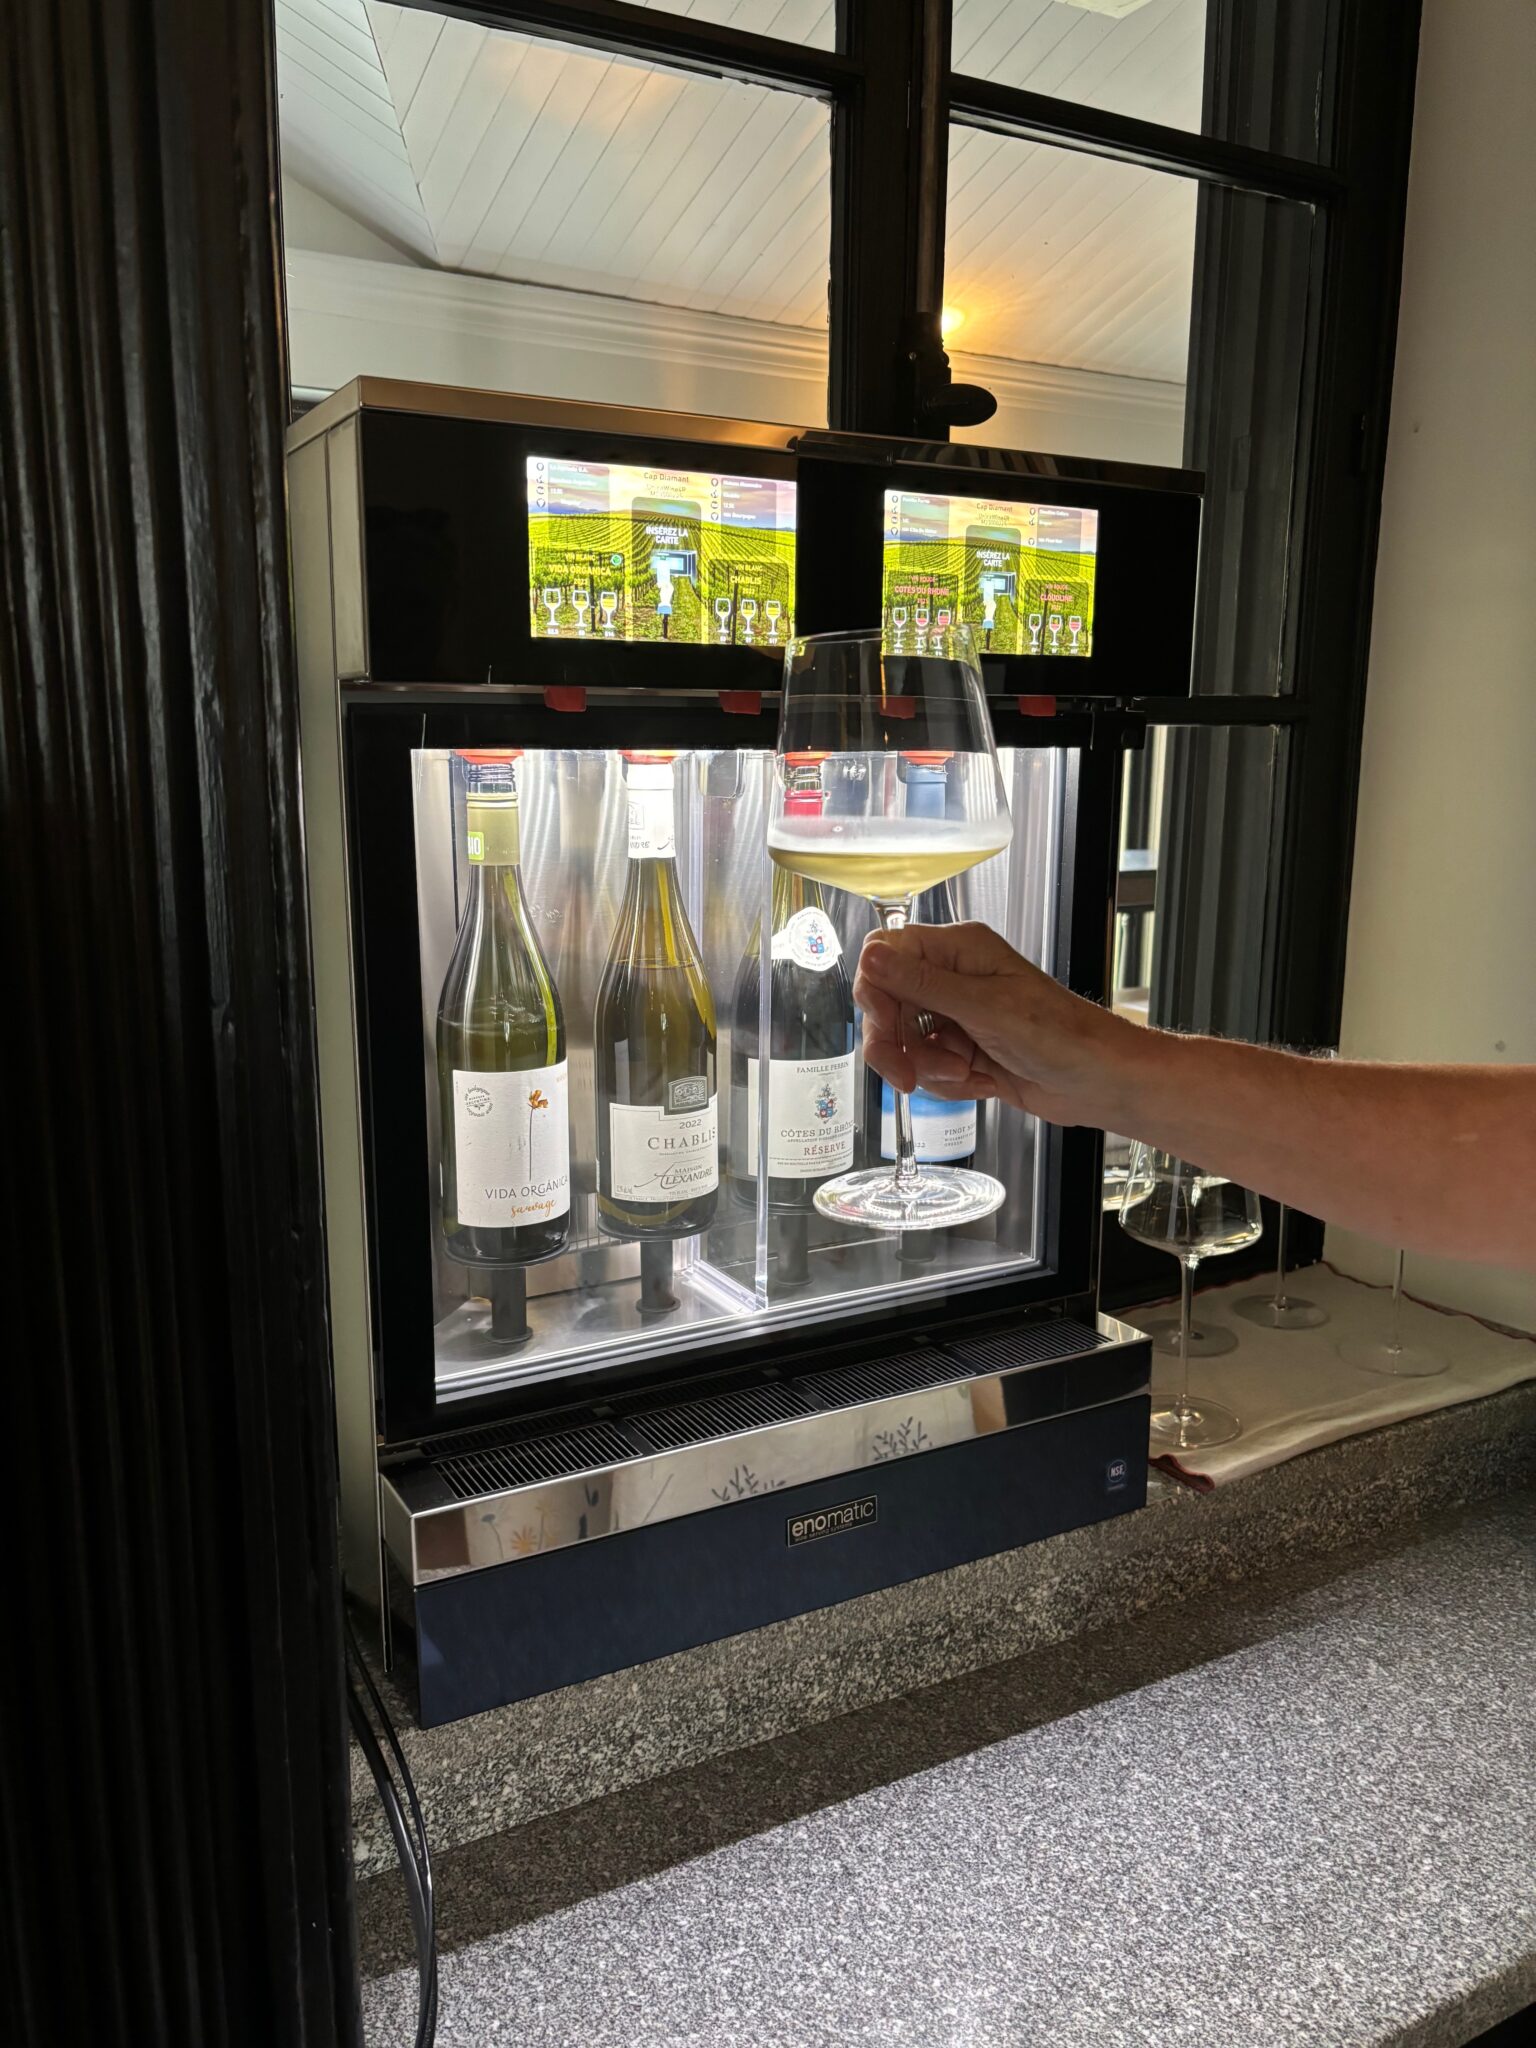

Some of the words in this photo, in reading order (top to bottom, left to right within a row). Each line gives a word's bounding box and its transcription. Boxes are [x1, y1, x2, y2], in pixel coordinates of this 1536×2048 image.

[679, 528, 689, 538] LA
[655, 535, 679, 545] CARTE
[1001, 552, 1010, 560] LA
[983, 559, 1002, 567] CARTE
[548, 564, 569, 574] VIDA
[730, 575, 762, 585] CHABLIS
[796, 1065, 829, 1074] FAMILLE
[679, 1119, 702, 1129] 2022
[780, 1128, 816, 1138] CÔTES
[818, 1127, 832, 1136] DU
[944, 1126, 965, 1136] PINOT
[803, 1140, 846, 1156] RÉSERVE
[674, 1163, 703, 1174] MAISON
[484, 1188, 517, 1199] VIDA
[520, 1175, 569, 1197] ORGÁNICA
[1110, 1464, 1124, 1478] NSF
[791, 1502, 874, 1537] enomatic
